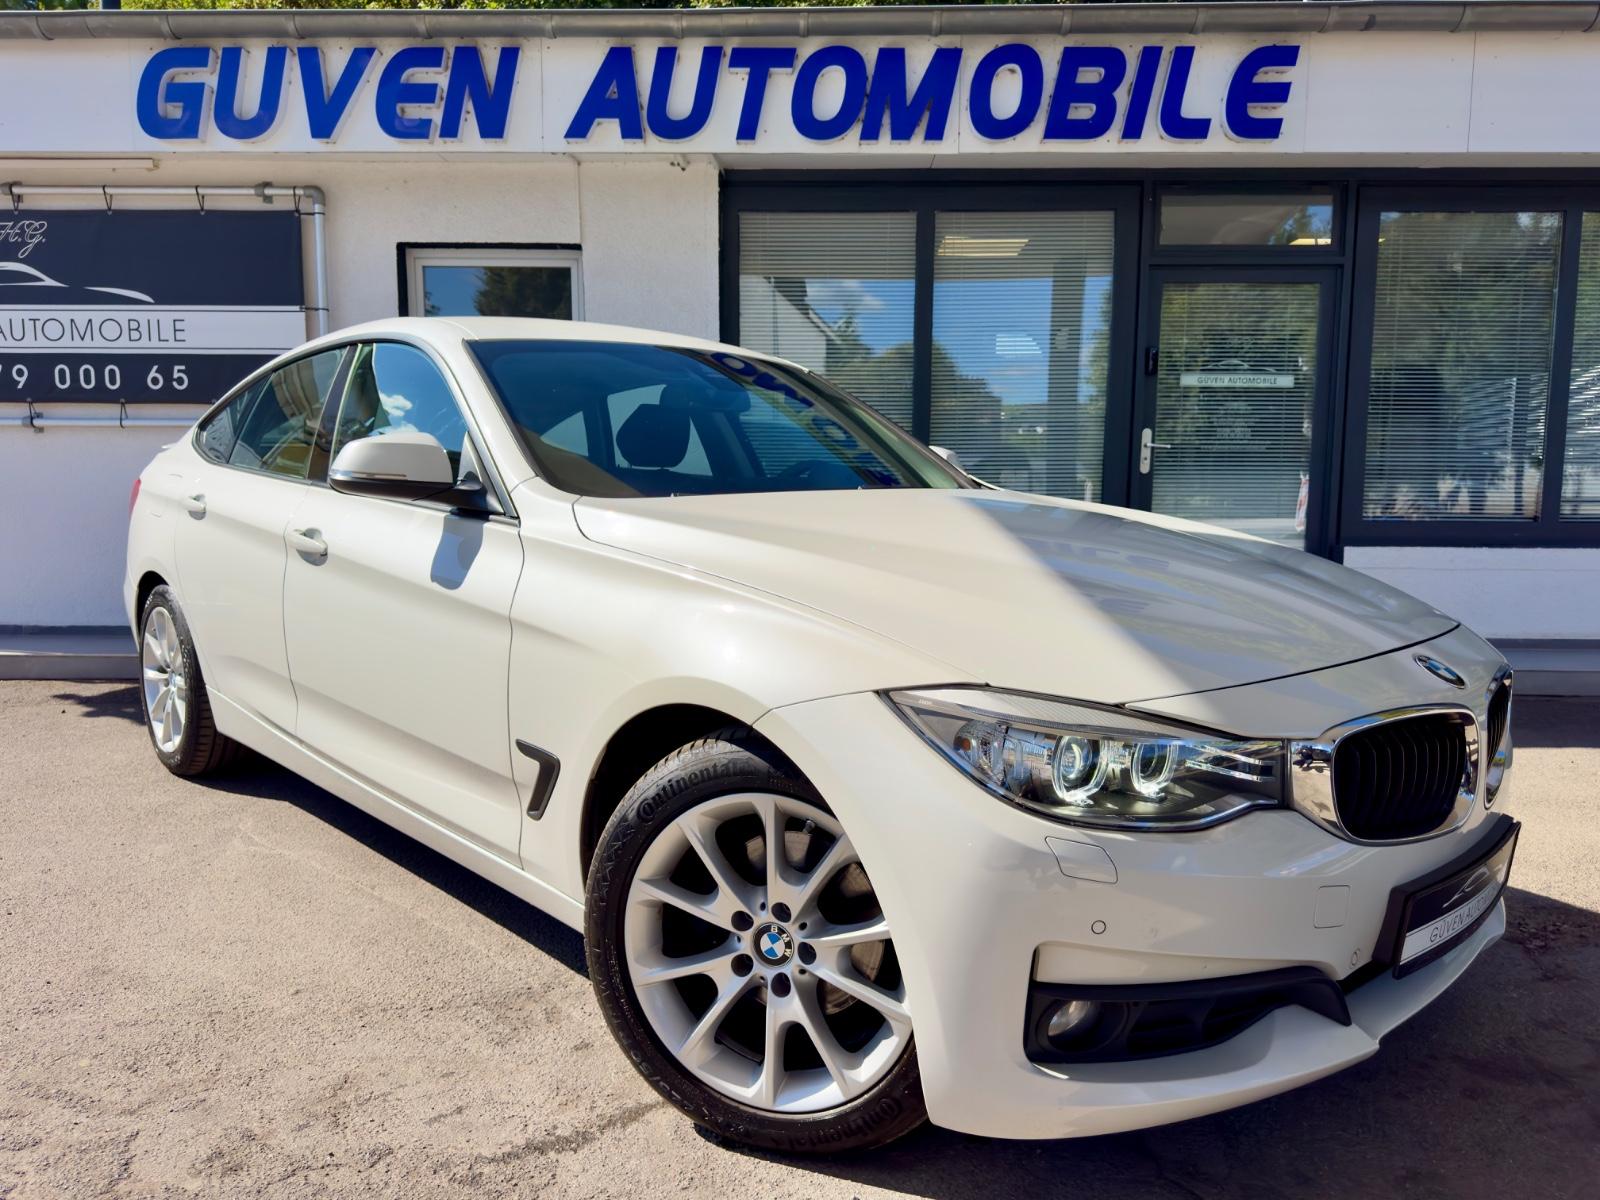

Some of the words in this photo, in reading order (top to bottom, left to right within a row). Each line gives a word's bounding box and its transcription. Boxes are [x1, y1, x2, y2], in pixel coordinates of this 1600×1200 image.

[137, 46, 521, 140] GUVEN
[564, 44, 1301, 142] AUTOMOBILE
[0, 364, 29, 390] 9
[54, 364, 121, 390] 000
[147, 364, 189, 391] 65
[1227, 376, 1278, 386] AUTOMOBILE
[637, 758, 737, 823] Continental
[770, 925, 792, 957] BMW
